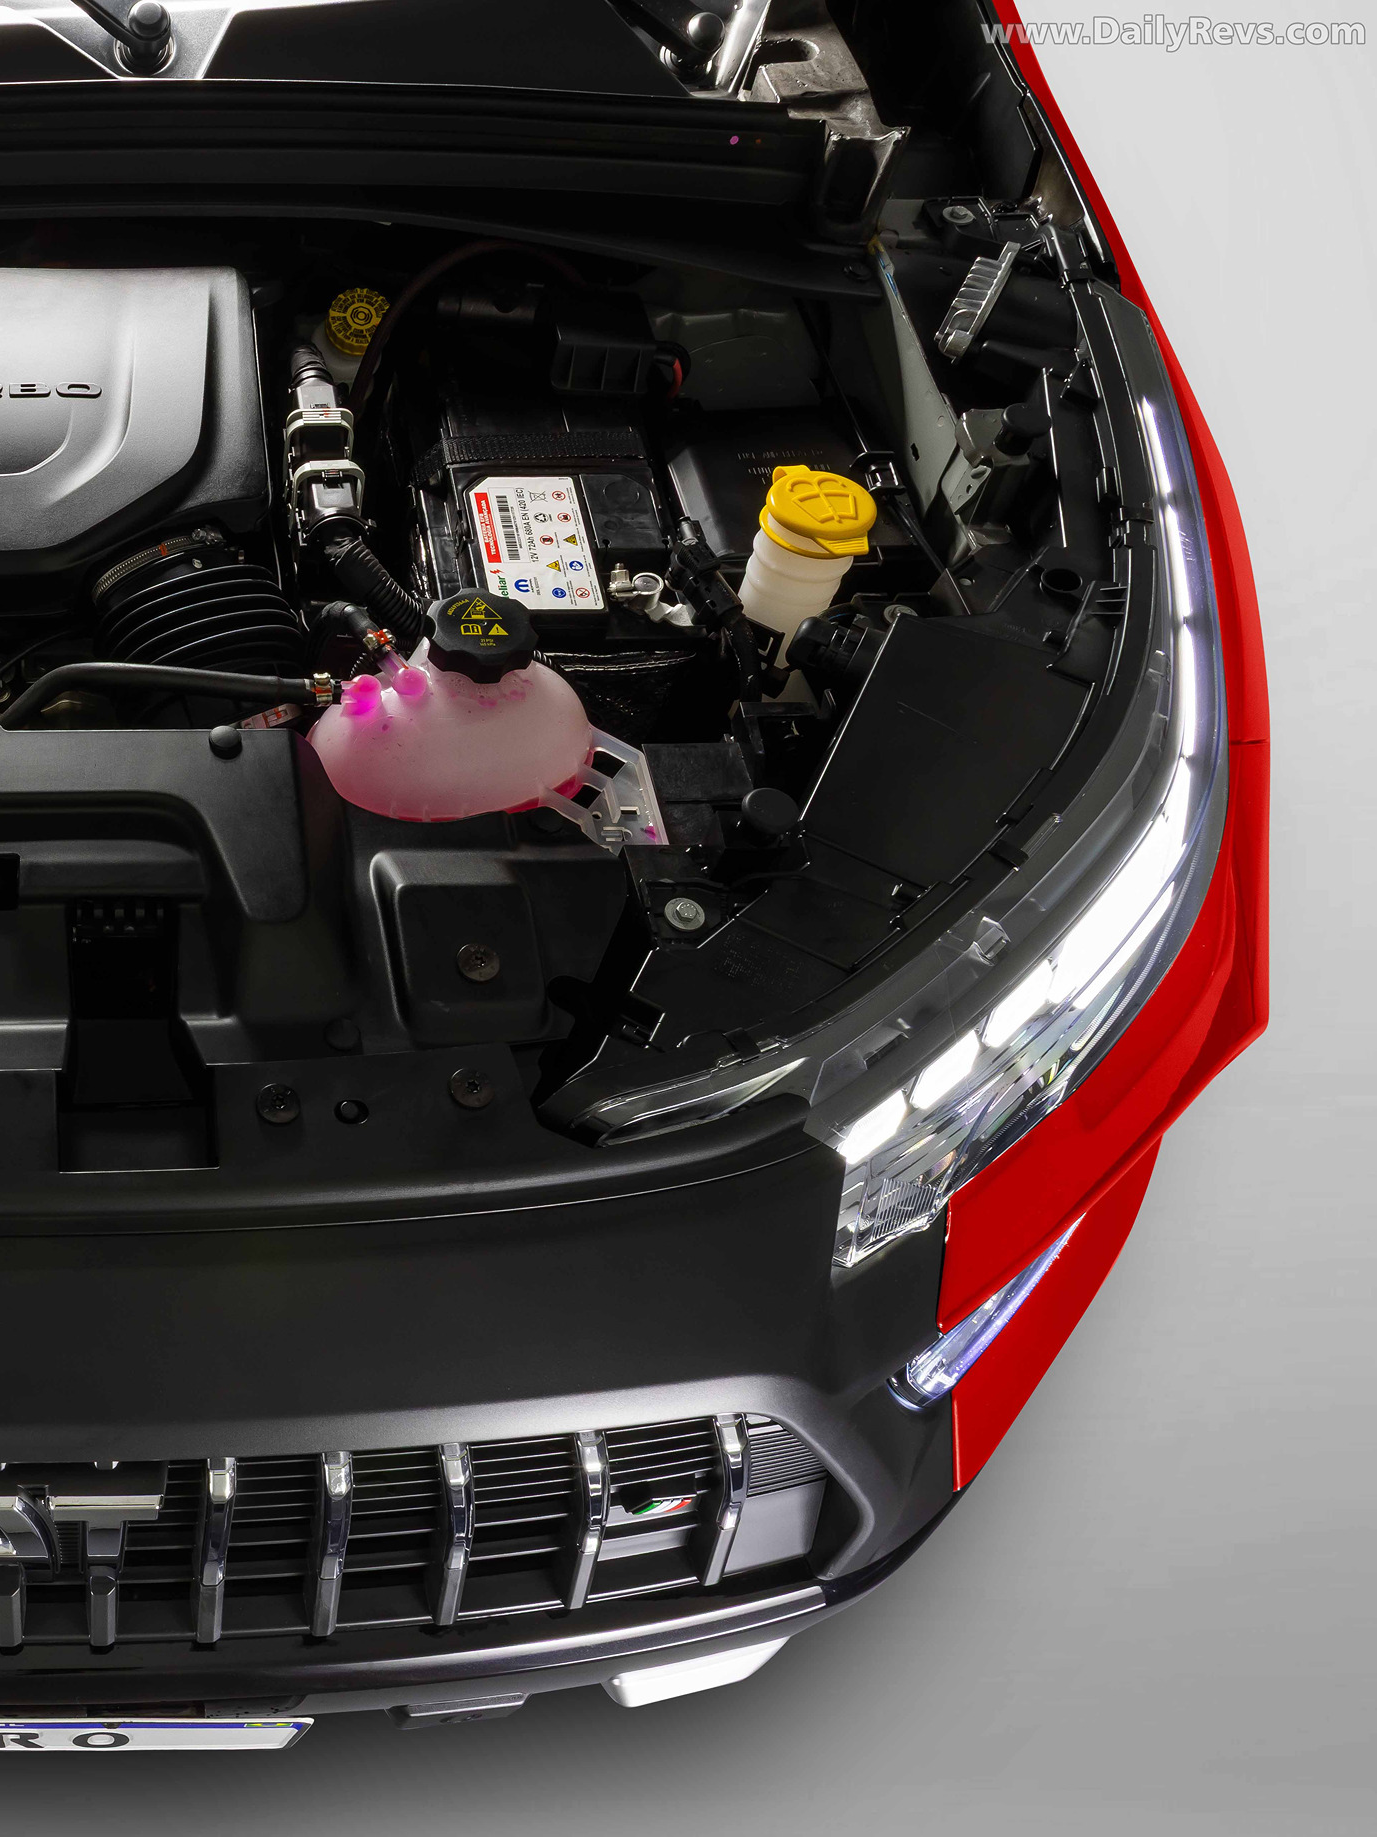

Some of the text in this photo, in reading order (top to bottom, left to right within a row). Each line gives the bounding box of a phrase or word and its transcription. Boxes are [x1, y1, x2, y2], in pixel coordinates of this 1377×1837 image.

[522, 511, 530, 521] EN
[524, 521, 533, 536] 680A
[527, 535, 536, 551] 72Ah
[529, 552, 539, 563] 12V
[498, 574, 509, 599] eliar
